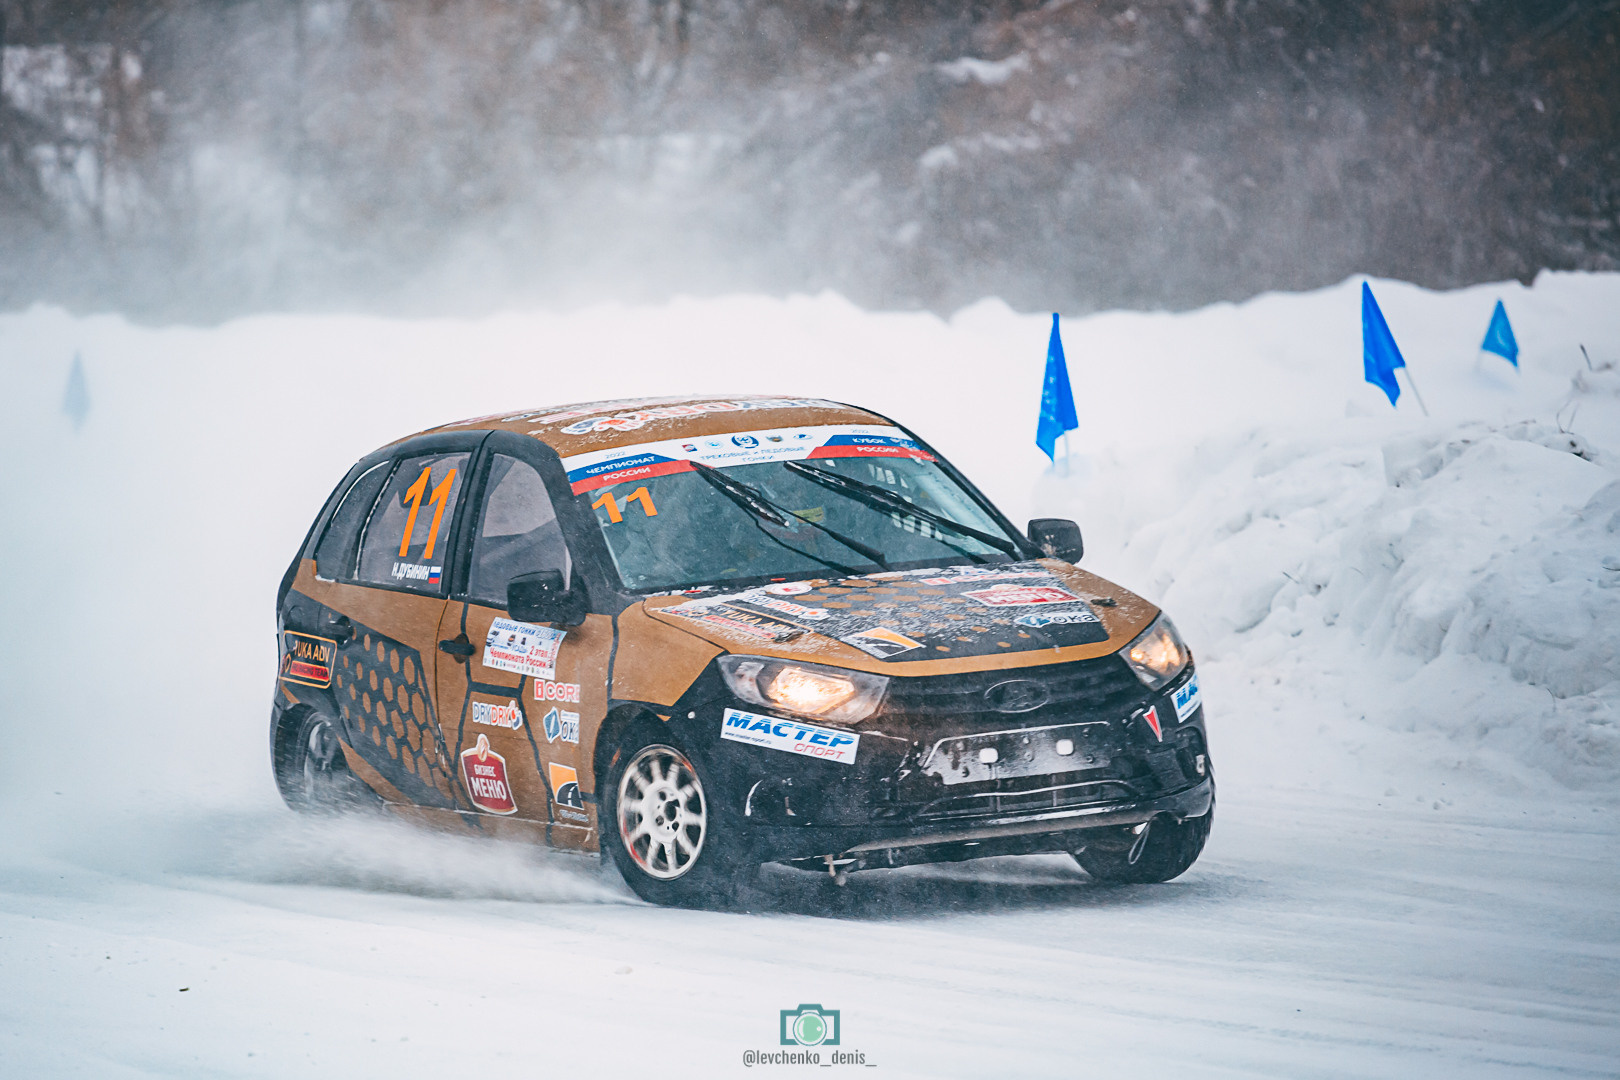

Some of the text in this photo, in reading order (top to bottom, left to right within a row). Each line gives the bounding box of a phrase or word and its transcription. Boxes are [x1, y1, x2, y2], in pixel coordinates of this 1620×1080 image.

[605, 451, 626, 459] 2022
[742, 455, 774, 463] ГОНКИ
[586, 455, 655, 474] ЧЕМПИОНАТ
[603, 467, 651, 481] РОССИИ
[399, 467, 457, 559] 11
[591, 486, 658, 524] 11
[529, 645, 535, 655] 2
[474, 704, 510, 725] DRYDRY
[726, 712, 855, 747] МАСТЕР
[793, 743, 846, 759] СПОРТ
[474, 764, 496, 777] БИЗНЕС
[471, 777, 507, 801] МЕНЮ
